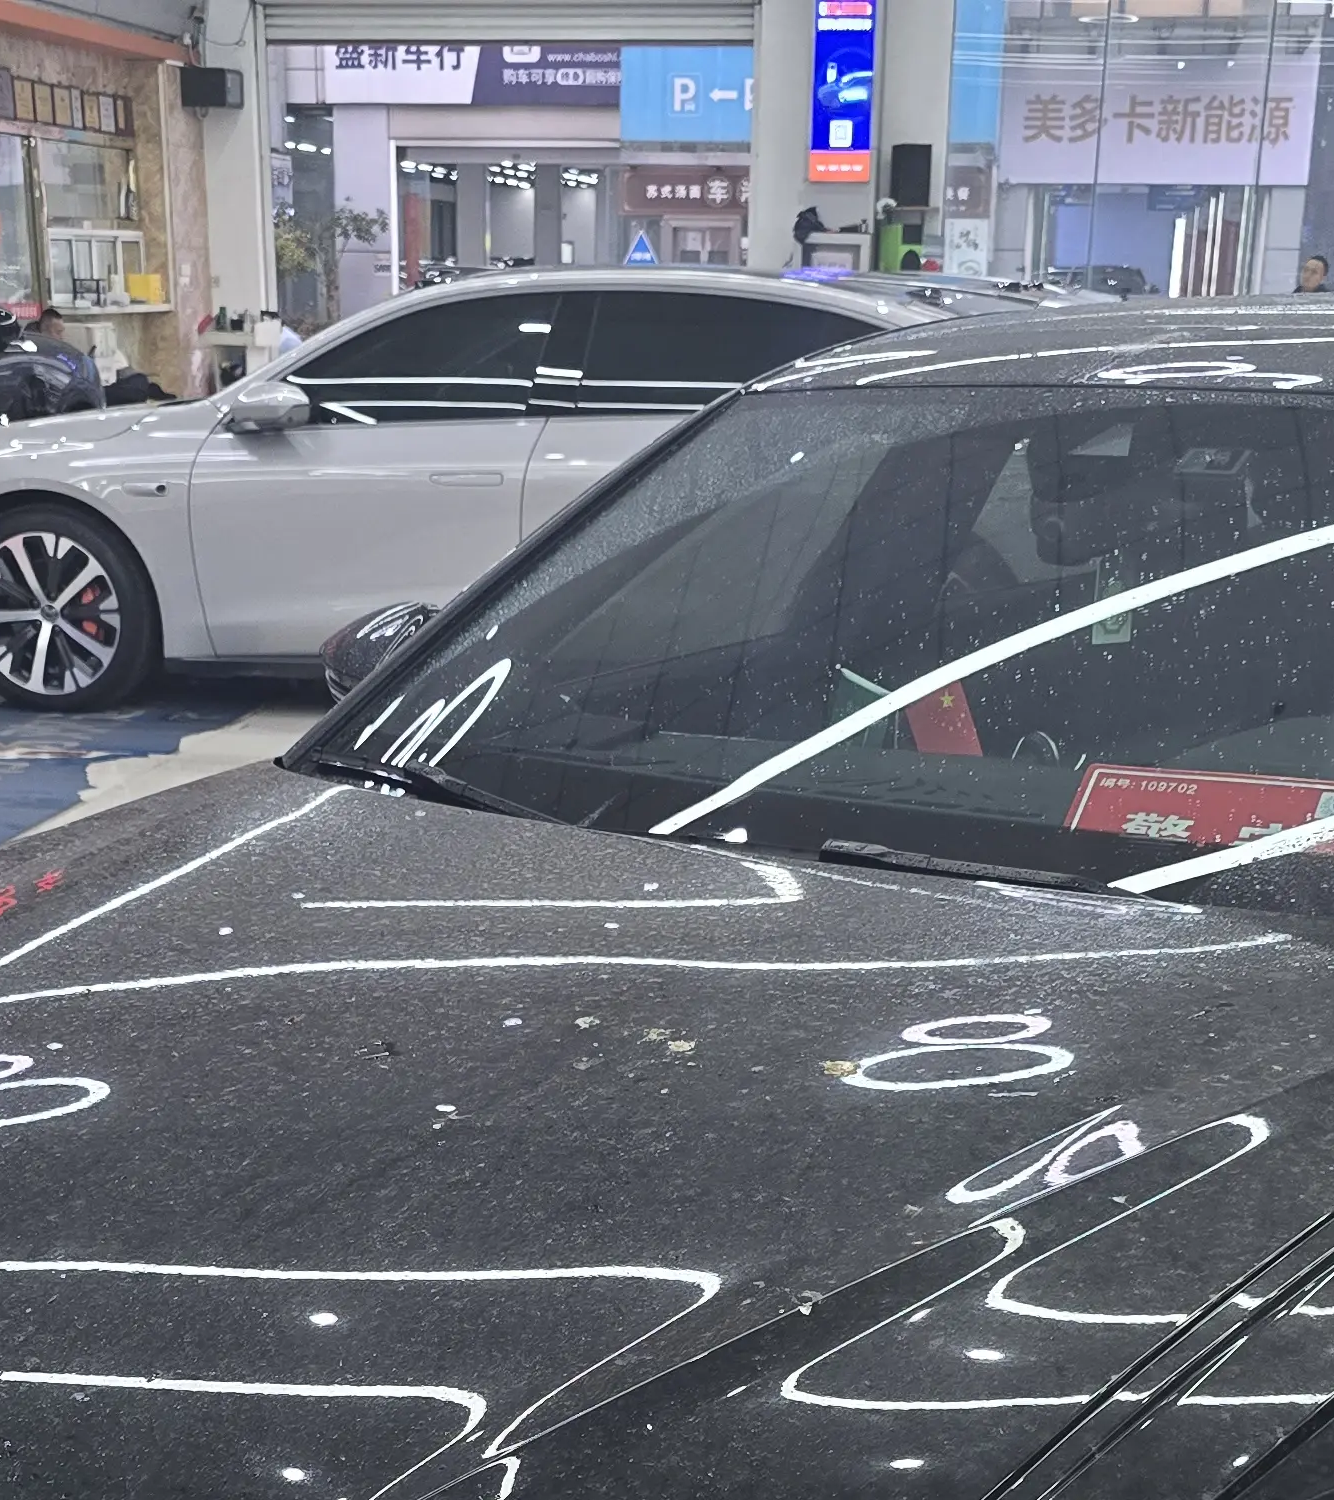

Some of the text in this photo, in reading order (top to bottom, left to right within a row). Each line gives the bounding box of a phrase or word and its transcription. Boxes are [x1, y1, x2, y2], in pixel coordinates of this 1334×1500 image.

[1022, 94, 1294, 146] 美多卡新能源
[1139, 780, 1199, 795] 109702
